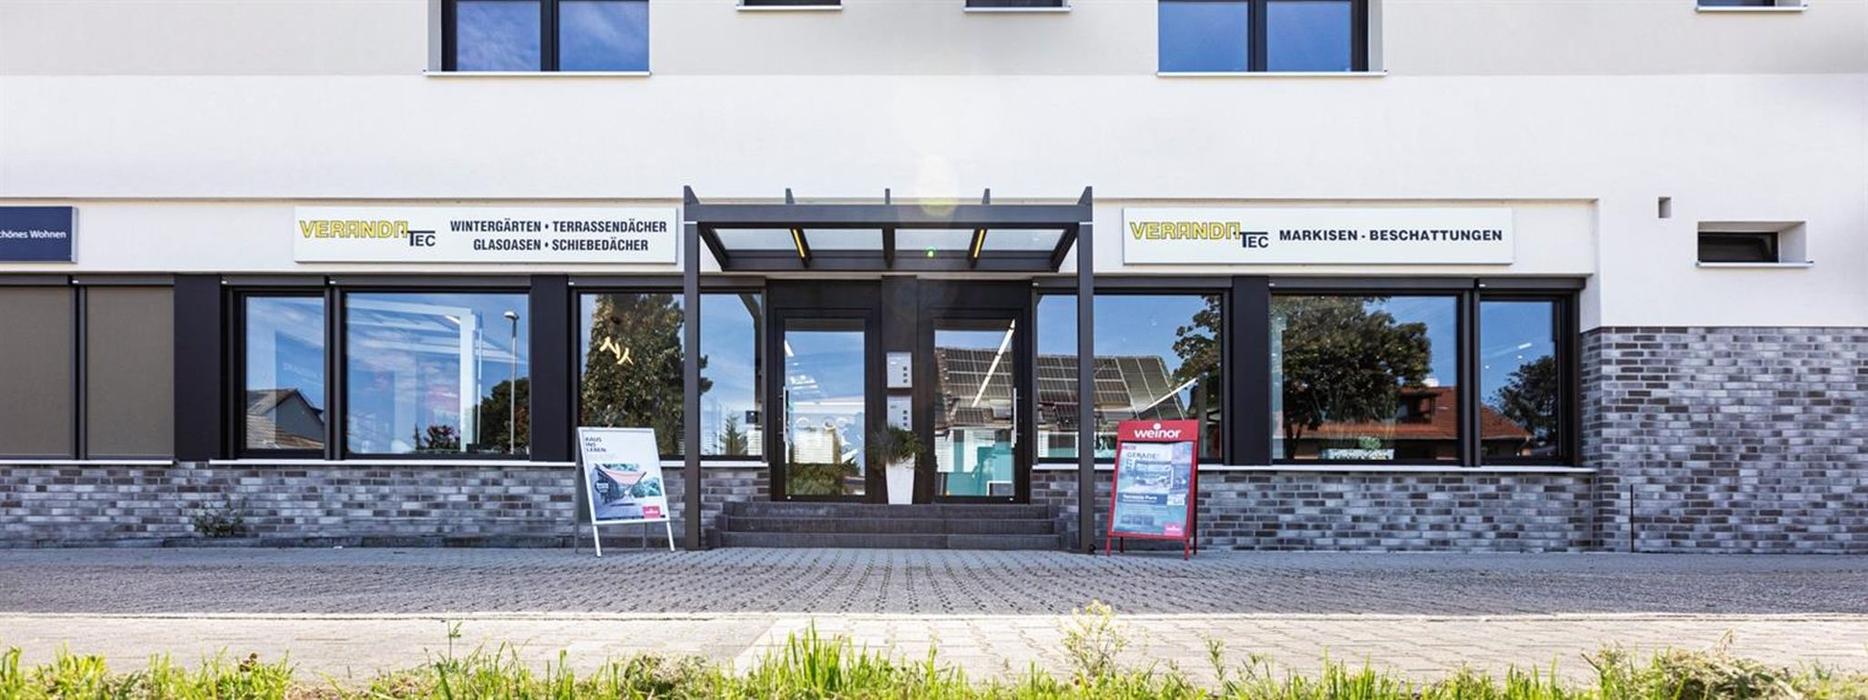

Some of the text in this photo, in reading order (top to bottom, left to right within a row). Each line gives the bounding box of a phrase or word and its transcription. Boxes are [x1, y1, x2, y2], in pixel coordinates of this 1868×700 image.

[450, 218, 667, 234] WINTERGÄRTEN TERRASSENDÄCHER
[29, 229, 67, 239] Wohnen
[1279, 229, 1502, 241] MARKISEN BESCHATTUNGEN
[473, 236, 649, 251] GLASOASEN SCHIEBEDÄCHER
[1134, 422, 1181, 438] weinor
